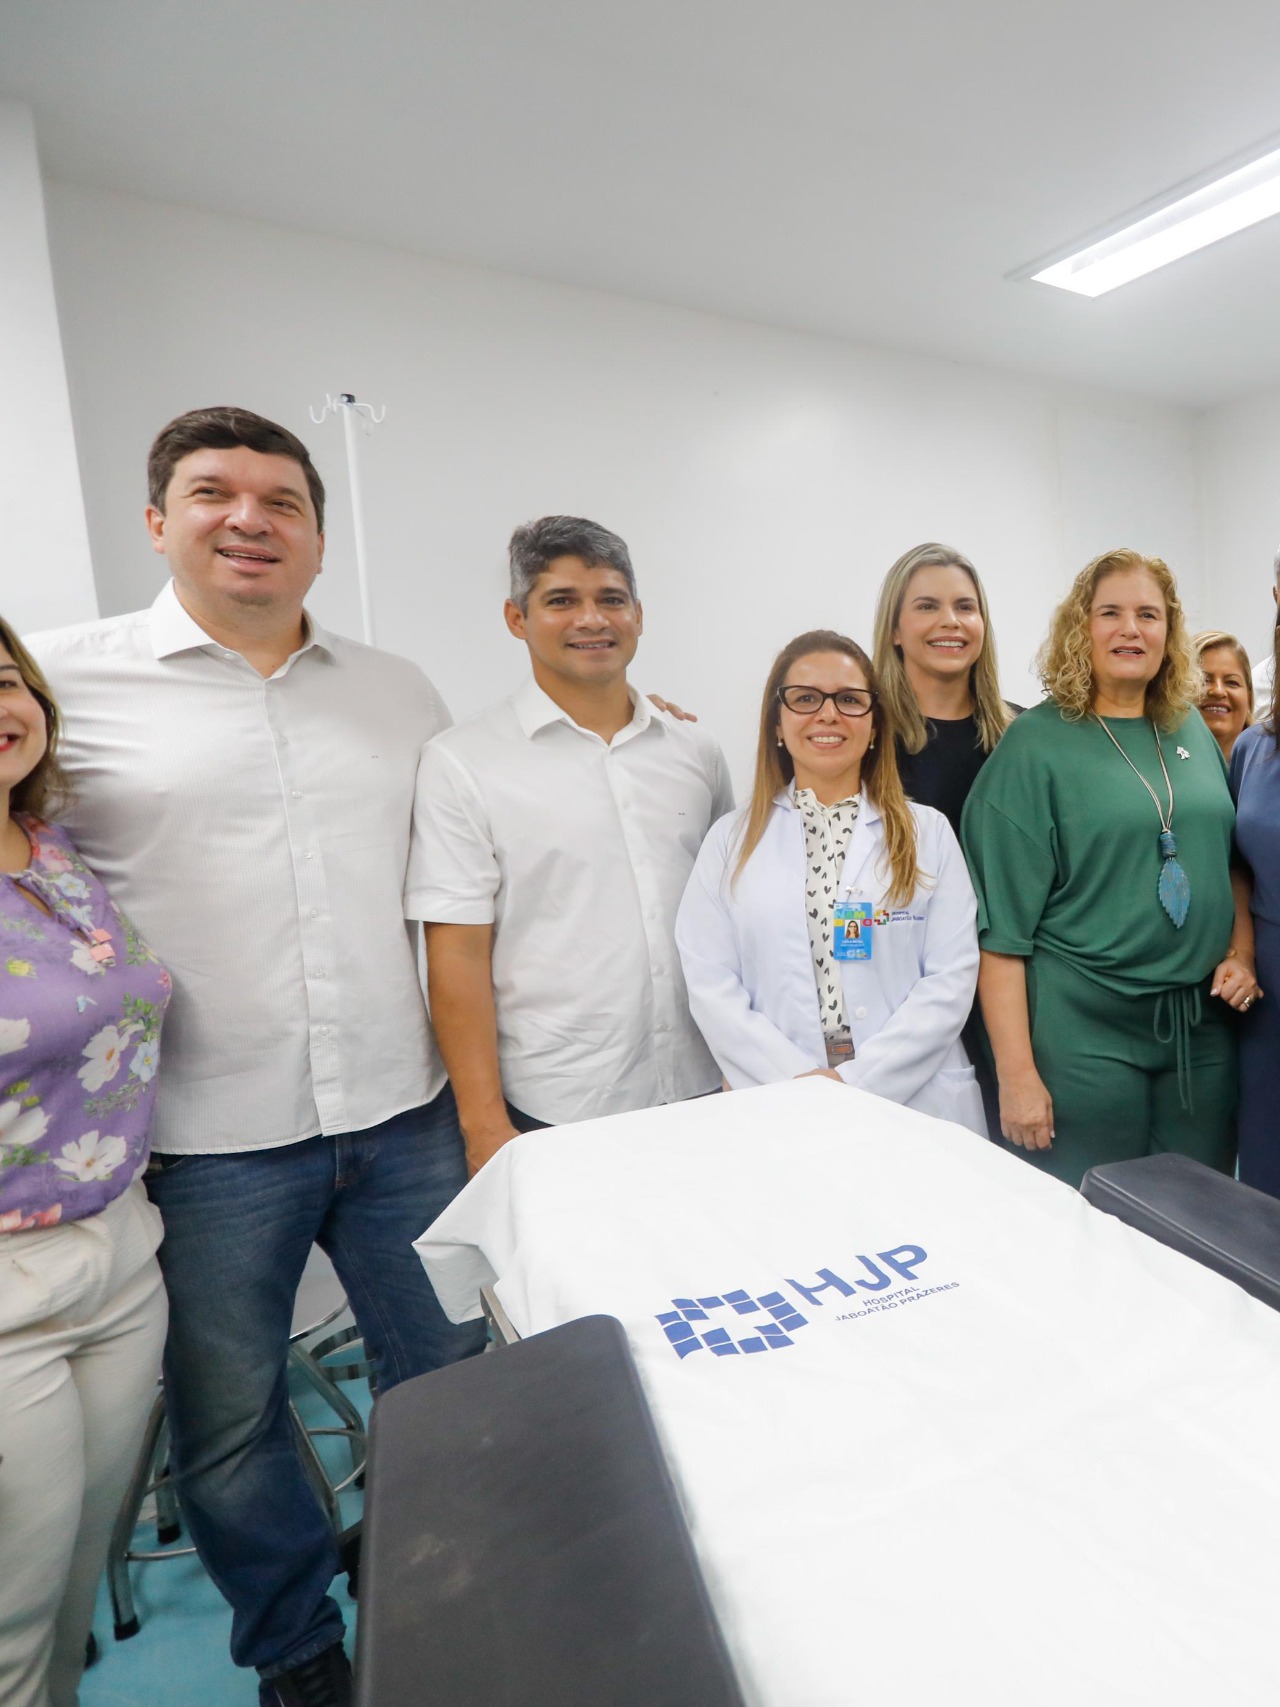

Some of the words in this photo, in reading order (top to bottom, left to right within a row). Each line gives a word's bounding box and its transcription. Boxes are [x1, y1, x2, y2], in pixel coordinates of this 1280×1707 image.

[784, 1245, 928, 1306] HJP
[835, 1302, 898, 1321] JABOATÃO
[899, 1282, 960, 1305] PRAZERES
[862, 1286, 920, 1307] HOSPITAL
